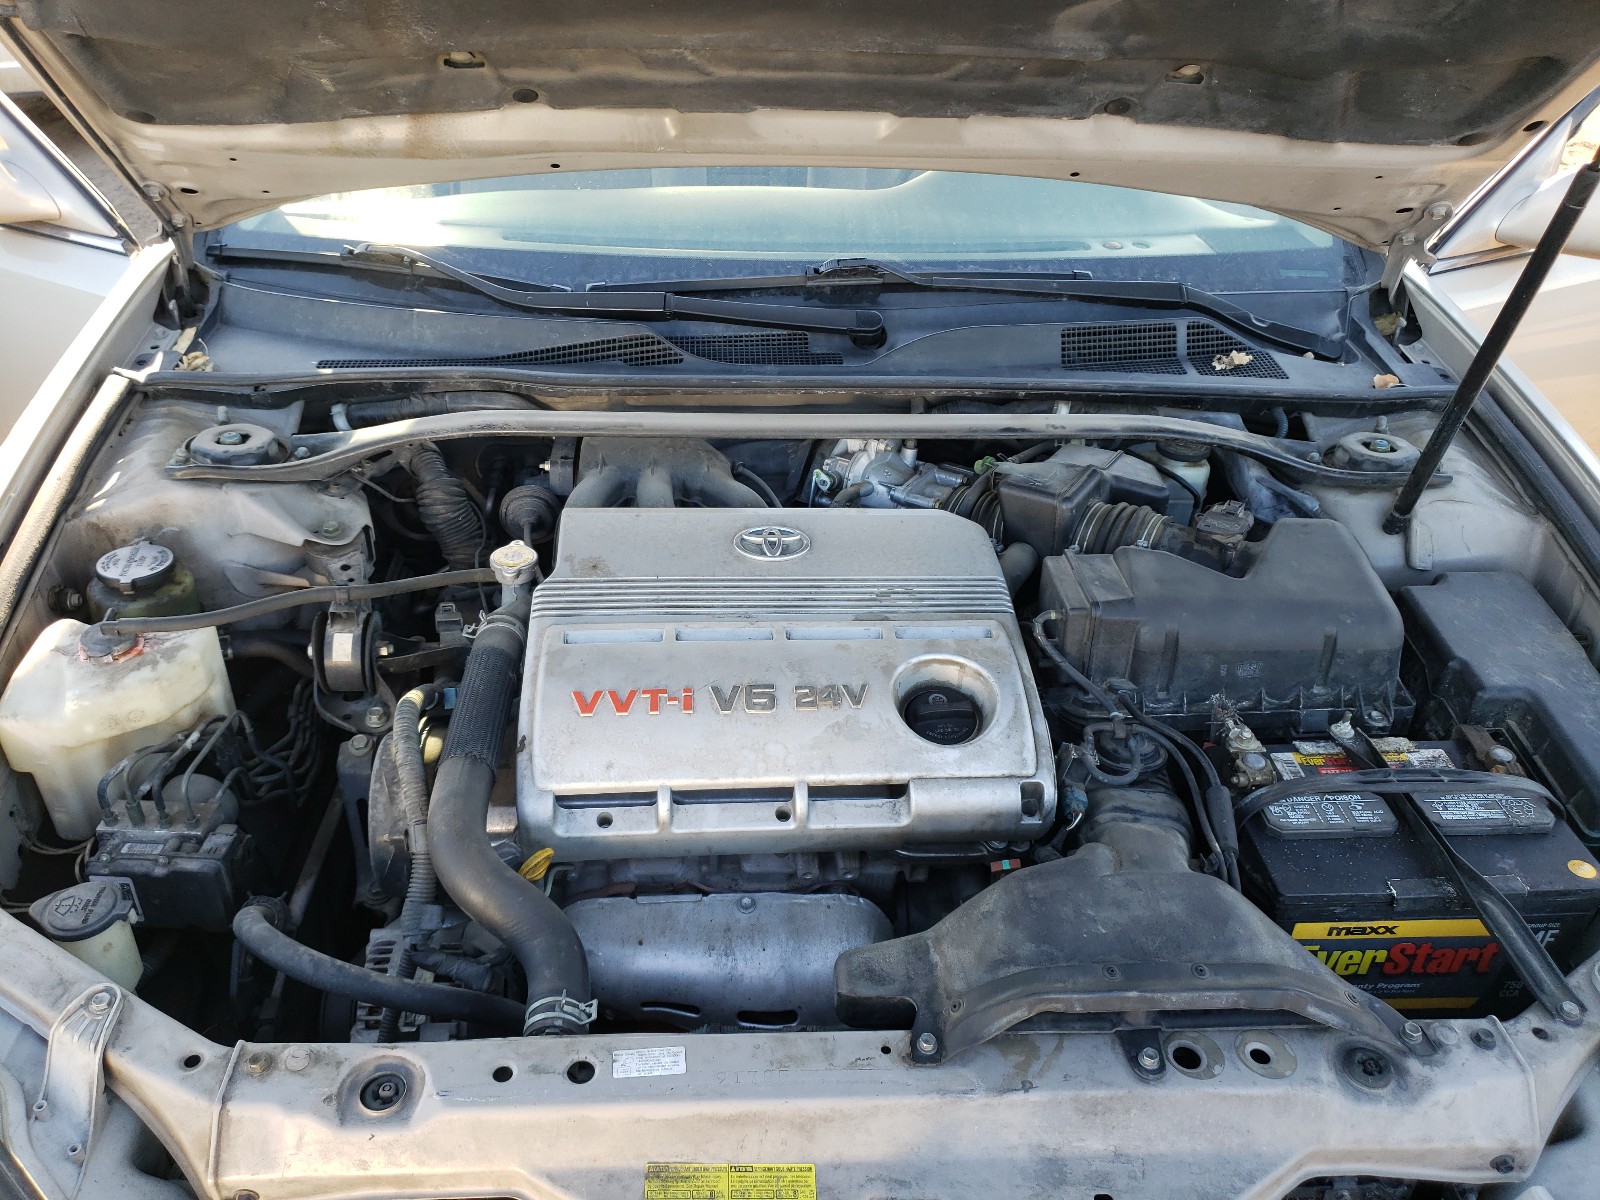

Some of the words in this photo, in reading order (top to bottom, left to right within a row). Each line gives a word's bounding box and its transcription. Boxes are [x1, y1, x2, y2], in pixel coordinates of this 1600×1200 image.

[571, 687, 694, 717] VVT-i
[709, 683, 777, 714] V6
[793, 684, 869, 711] 24V
[1327, 925, 1400, 937] maxx
[1376, 982, 1421, 990] Program
